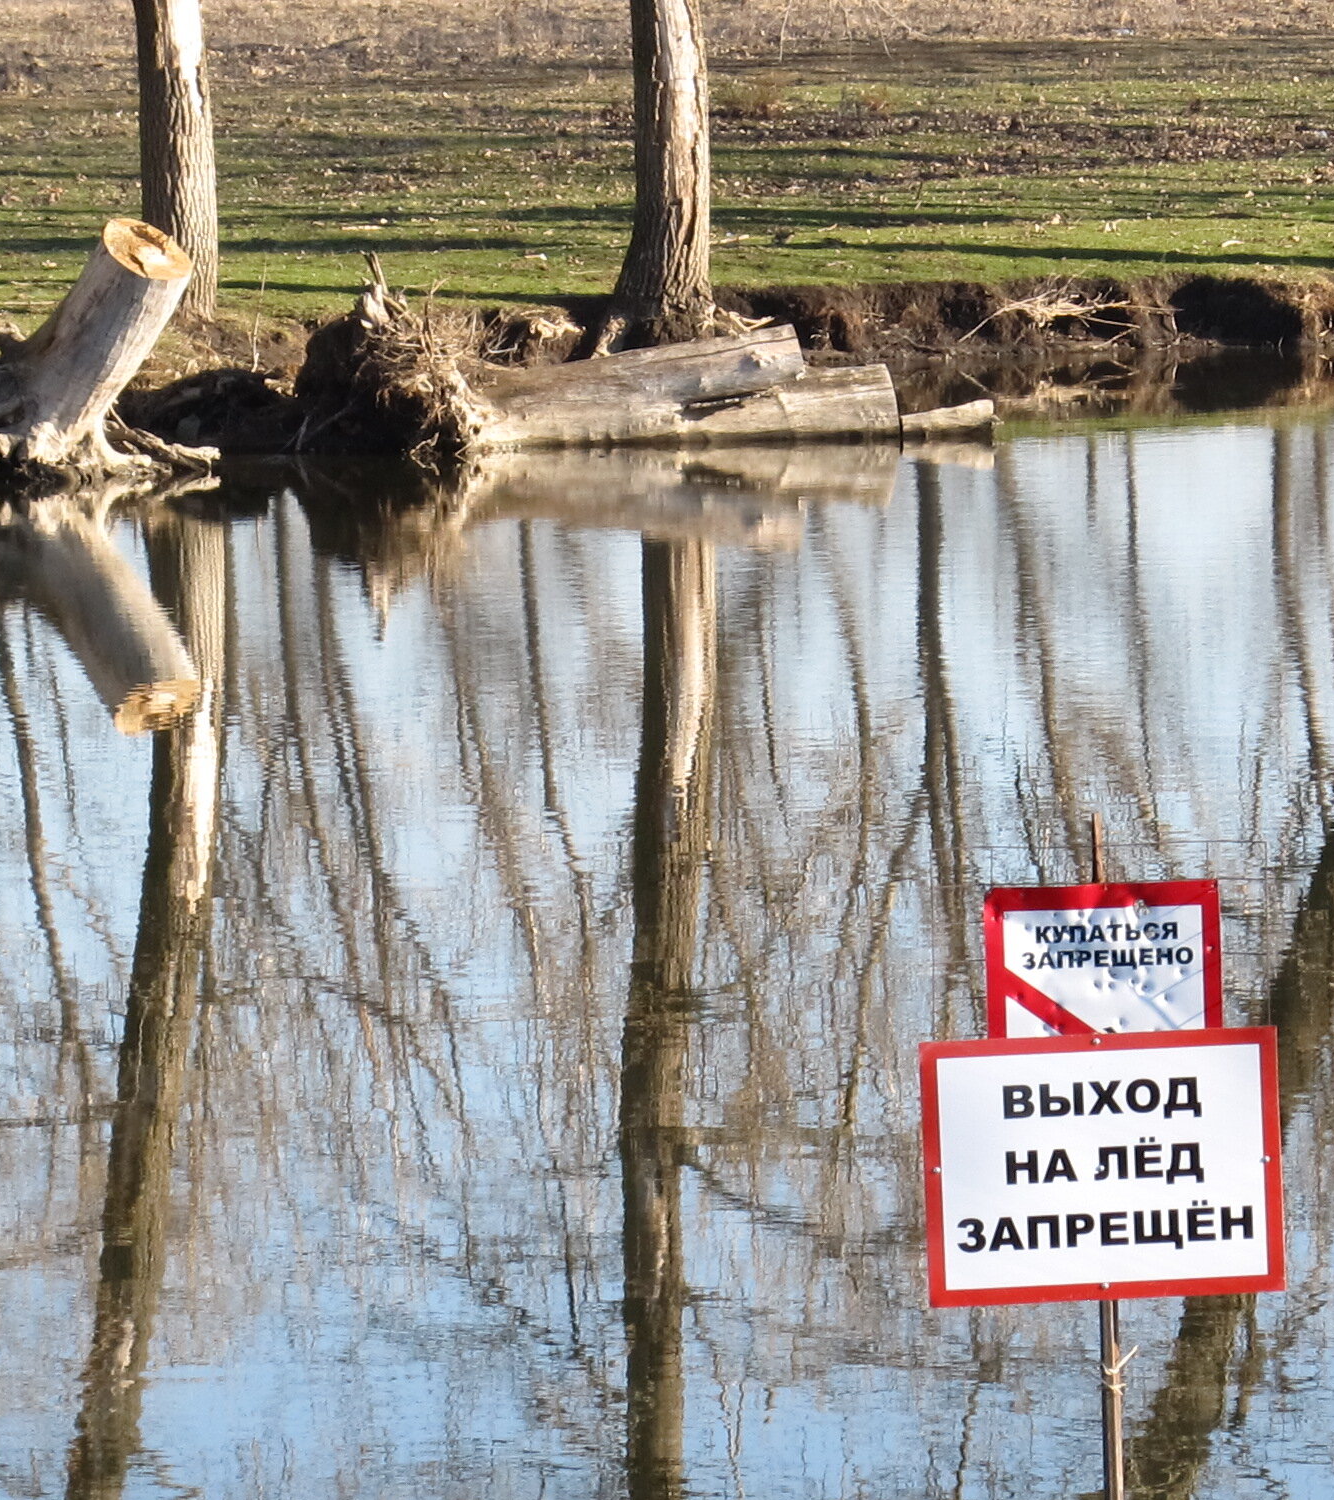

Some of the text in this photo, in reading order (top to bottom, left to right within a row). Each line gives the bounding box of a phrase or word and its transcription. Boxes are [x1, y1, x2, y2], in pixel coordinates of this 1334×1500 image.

[1035, 921, 1179, 944] КУПАТЬСЯ
[1021, 946, 1194, 970] ЗАПРЕЩЕНО
[1002, 1076, 1202, 1119] ВЫХОД
[1005, 1137, 1205, 1185] НА ЛЁД
[957, 1200, 1255, 1253] ЗАПРЕЩЁН
